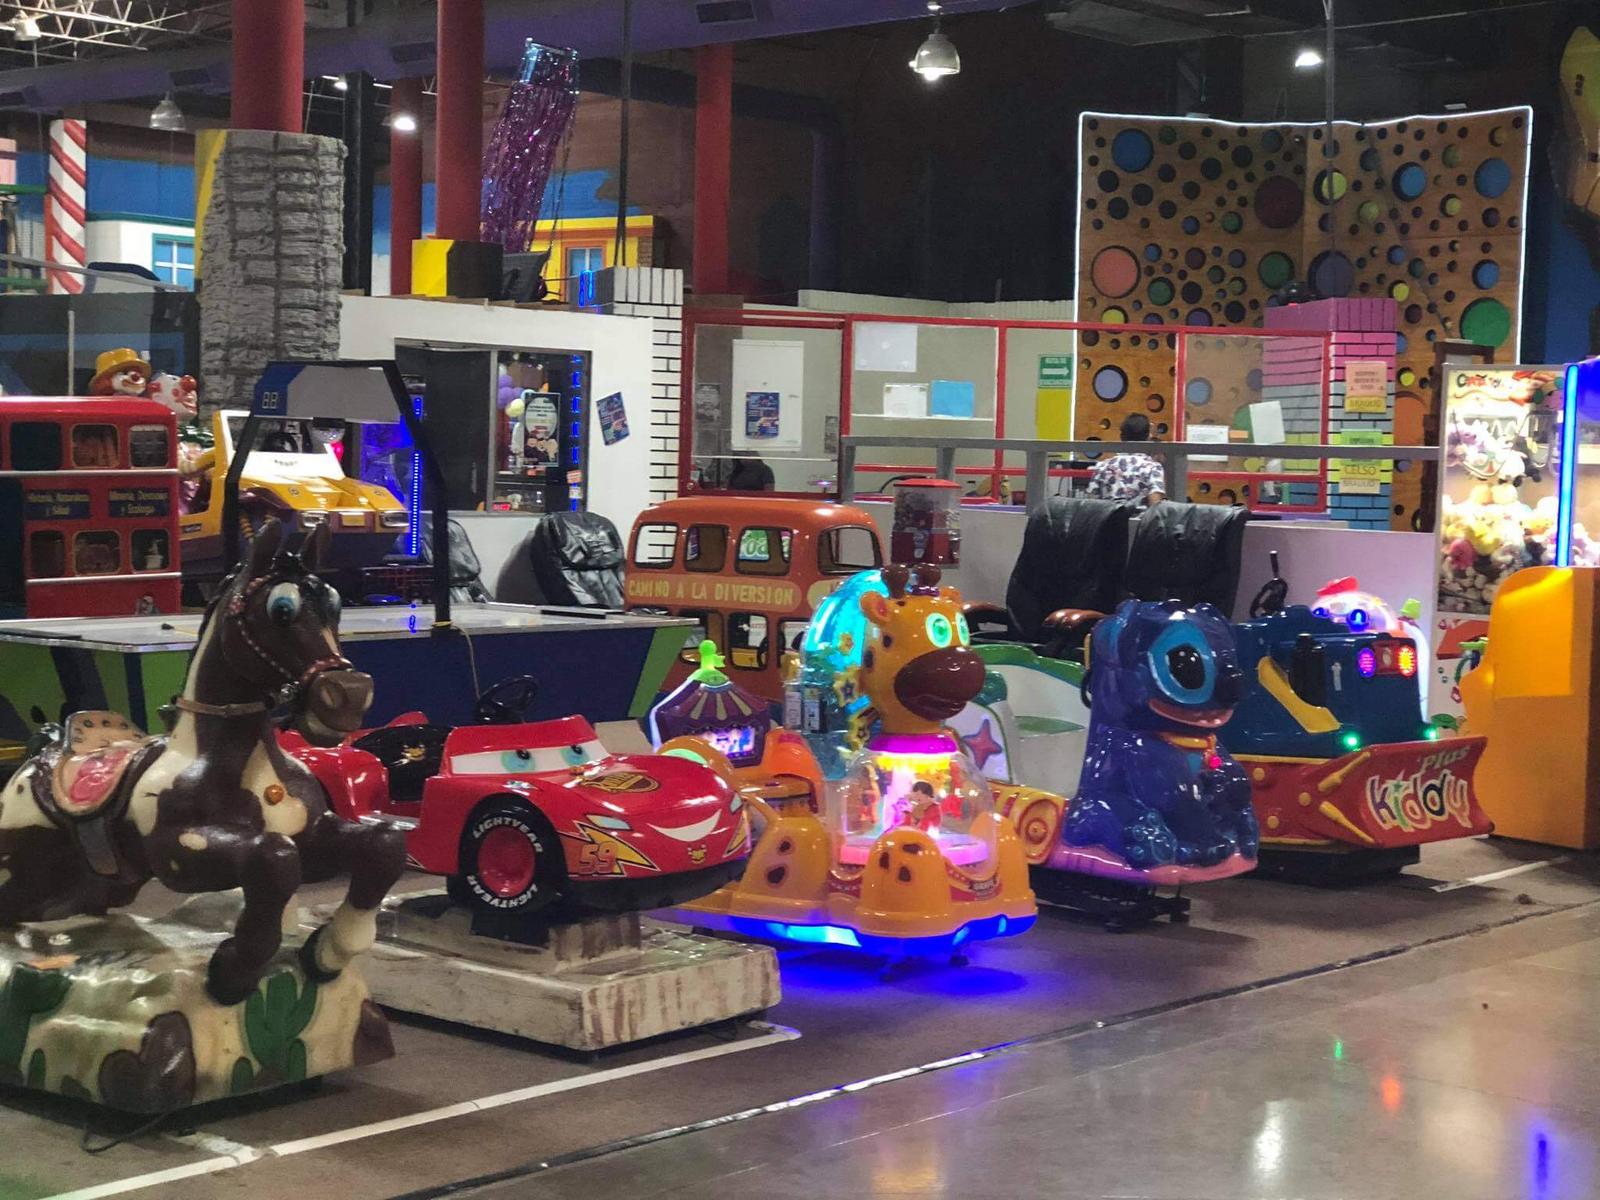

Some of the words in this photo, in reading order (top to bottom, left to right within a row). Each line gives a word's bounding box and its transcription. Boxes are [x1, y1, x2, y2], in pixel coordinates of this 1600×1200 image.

[629, 580, 669, 597] CAMINO
[676, 582, 684, 598] A
[692, 582, 707, 600] LA
[714, 583, 794, 605] DIVERSION
[472, 816, 544, 853] LIGHTYEAR
[578, 840, 618, 875] 59
[466, 874, 538, 909] LIGHTYEAR
